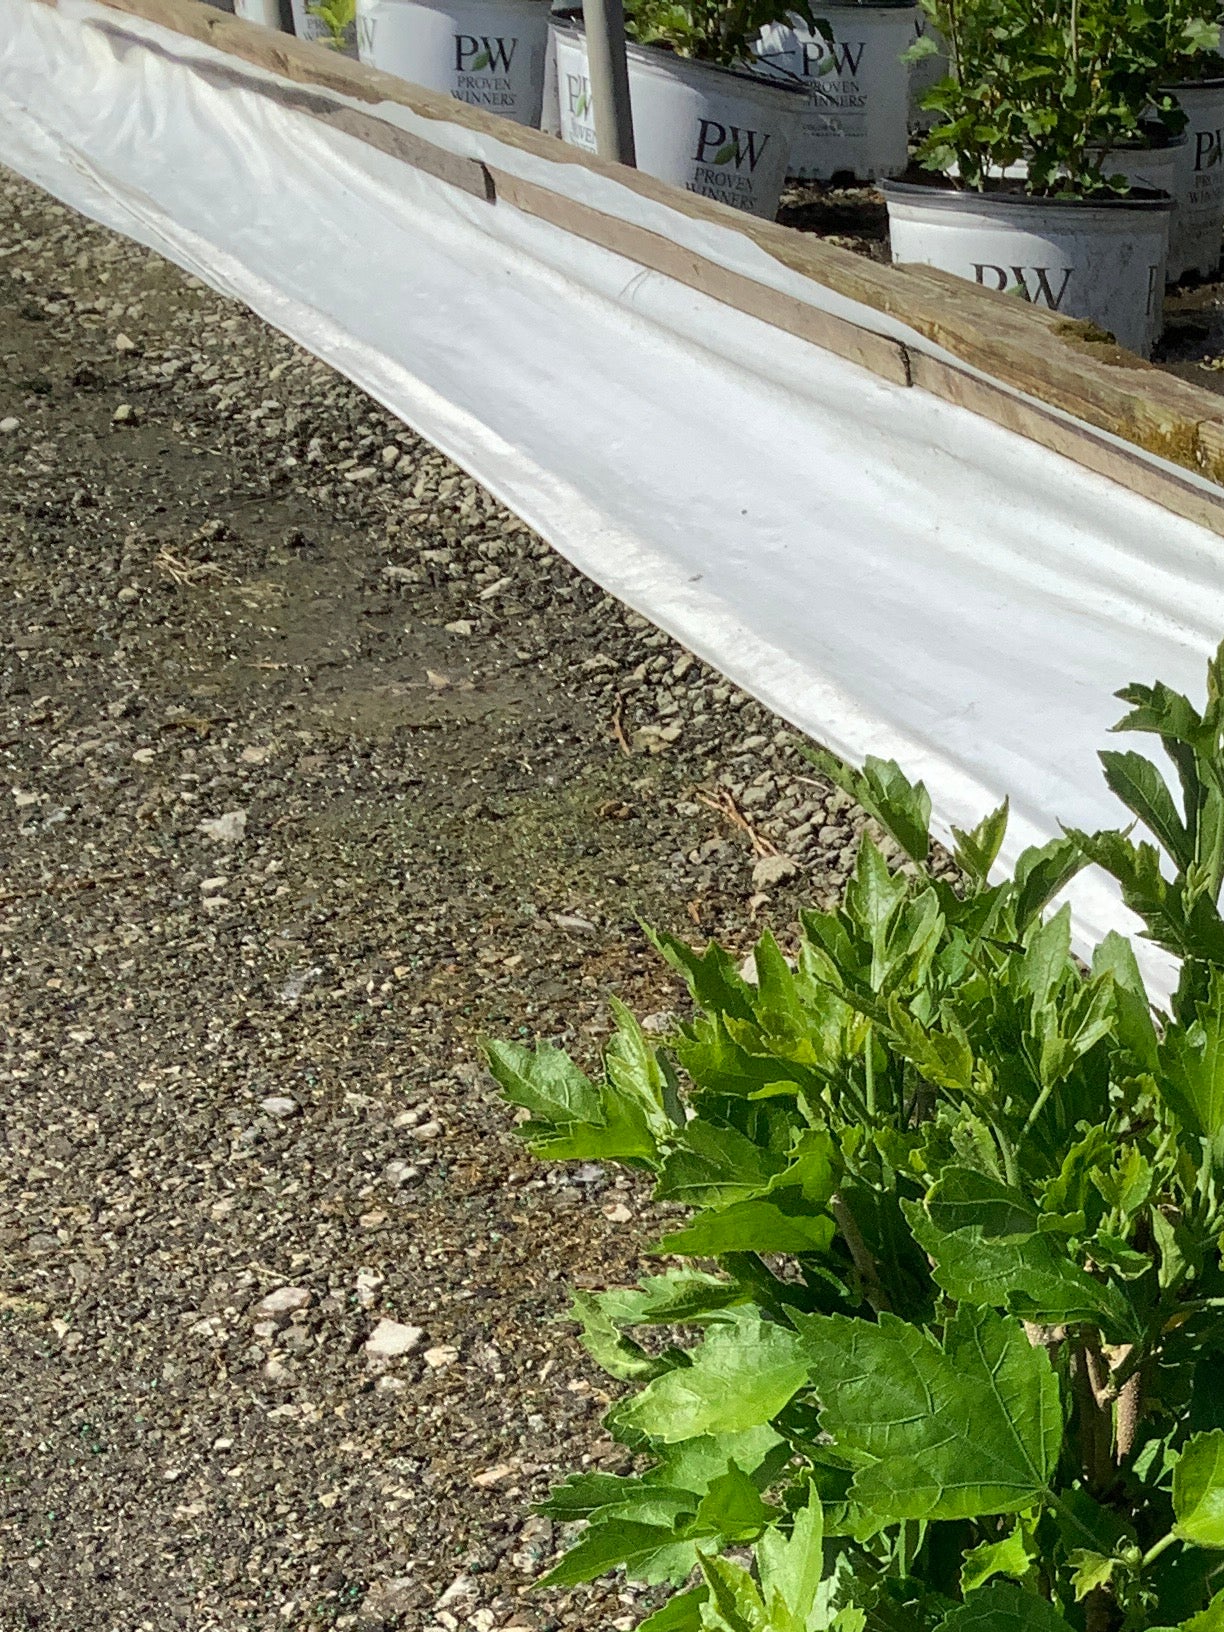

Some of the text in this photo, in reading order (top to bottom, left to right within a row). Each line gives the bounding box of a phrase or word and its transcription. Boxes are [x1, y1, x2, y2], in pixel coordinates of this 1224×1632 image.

[455, 35, 518, 73] PW
[801, 42, 867, 77] PW
[458, 76, 512, 90] PROVEN
[692, 118, 770, 172] PW
[695, 168, 753, 192] PROVEN
